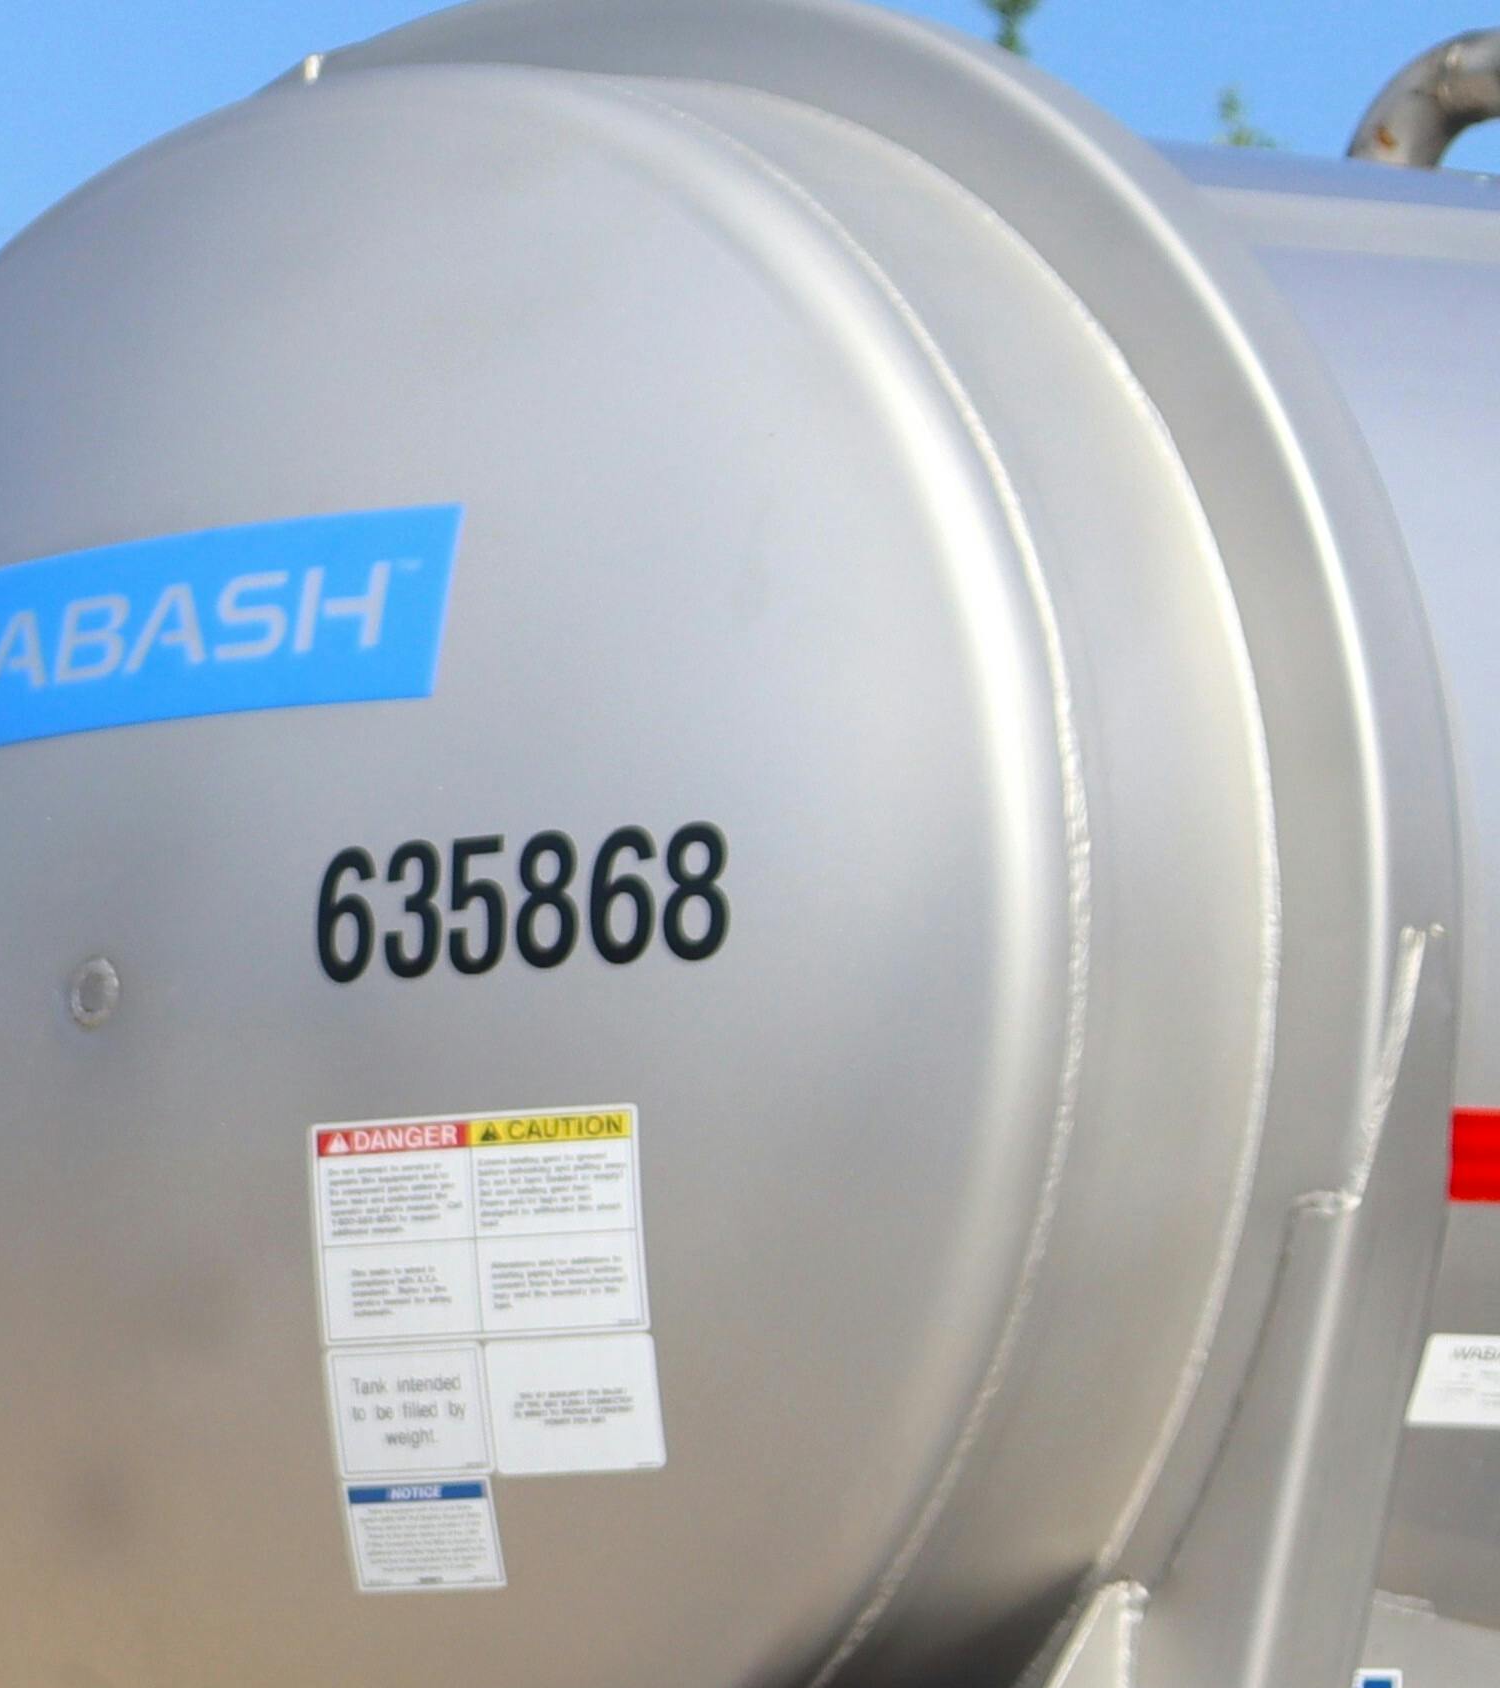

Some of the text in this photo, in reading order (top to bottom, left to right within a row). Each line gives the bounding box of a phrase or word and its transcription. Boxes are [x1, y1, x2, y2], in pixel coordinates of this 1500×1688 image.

[316, 820, 731, 984] 635868
[354, 1124, 458, 1152] DANGER
[507, 1114, 624, 1140] CAUTION
[352, 1374, 461, 1395] Tank intended
[352, 1401, 465, 1421] to be filled by
[389, 1485, 443, 1500] NOTICE
